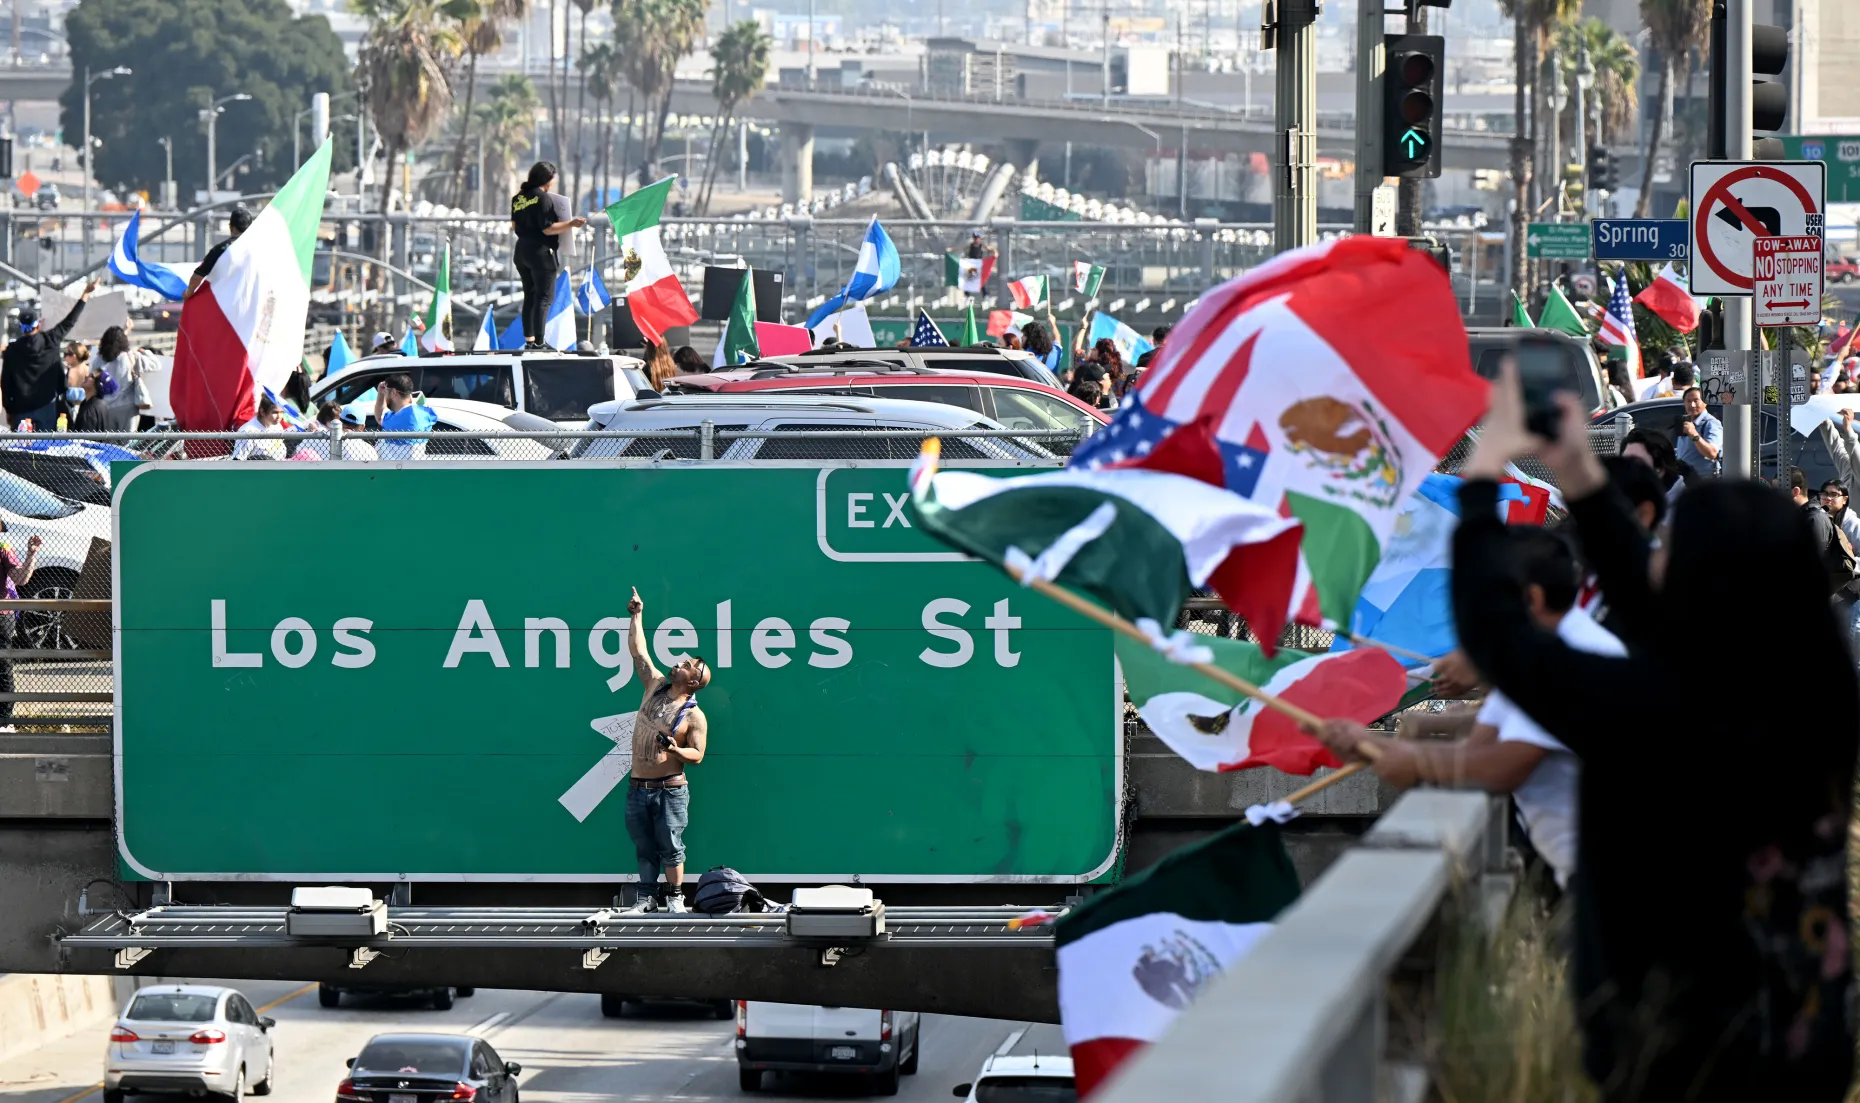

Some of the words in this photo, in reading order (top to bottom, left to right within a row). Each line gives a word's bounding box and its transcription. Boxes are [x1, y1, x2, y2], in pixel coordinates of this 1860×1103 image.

[1849, 165, 1860, 178] S
[1375, 193, 1391, 203] BUS
[1374, 207, 1392, 218] ONLY
[1805, 214, 1823, 226] USER
[1599, 222, 1659, 250] Spring
[1668, 243, 1689, 258] 30
[1756, 239, 1819, 251] TOW-AWAY
[1755, 256, 1774, 278] NO
[1776, 257, 1819, 275] STOPPING
[1762, 284, 1784, 298] ANY
[1790, 283, 1813, 297] TIME
[848, 493, 912, 528] EX
[211, 599, 377, 669] Los
[442, 598, 853, 693] Angeles
[918, 597, 1023, 669] St
